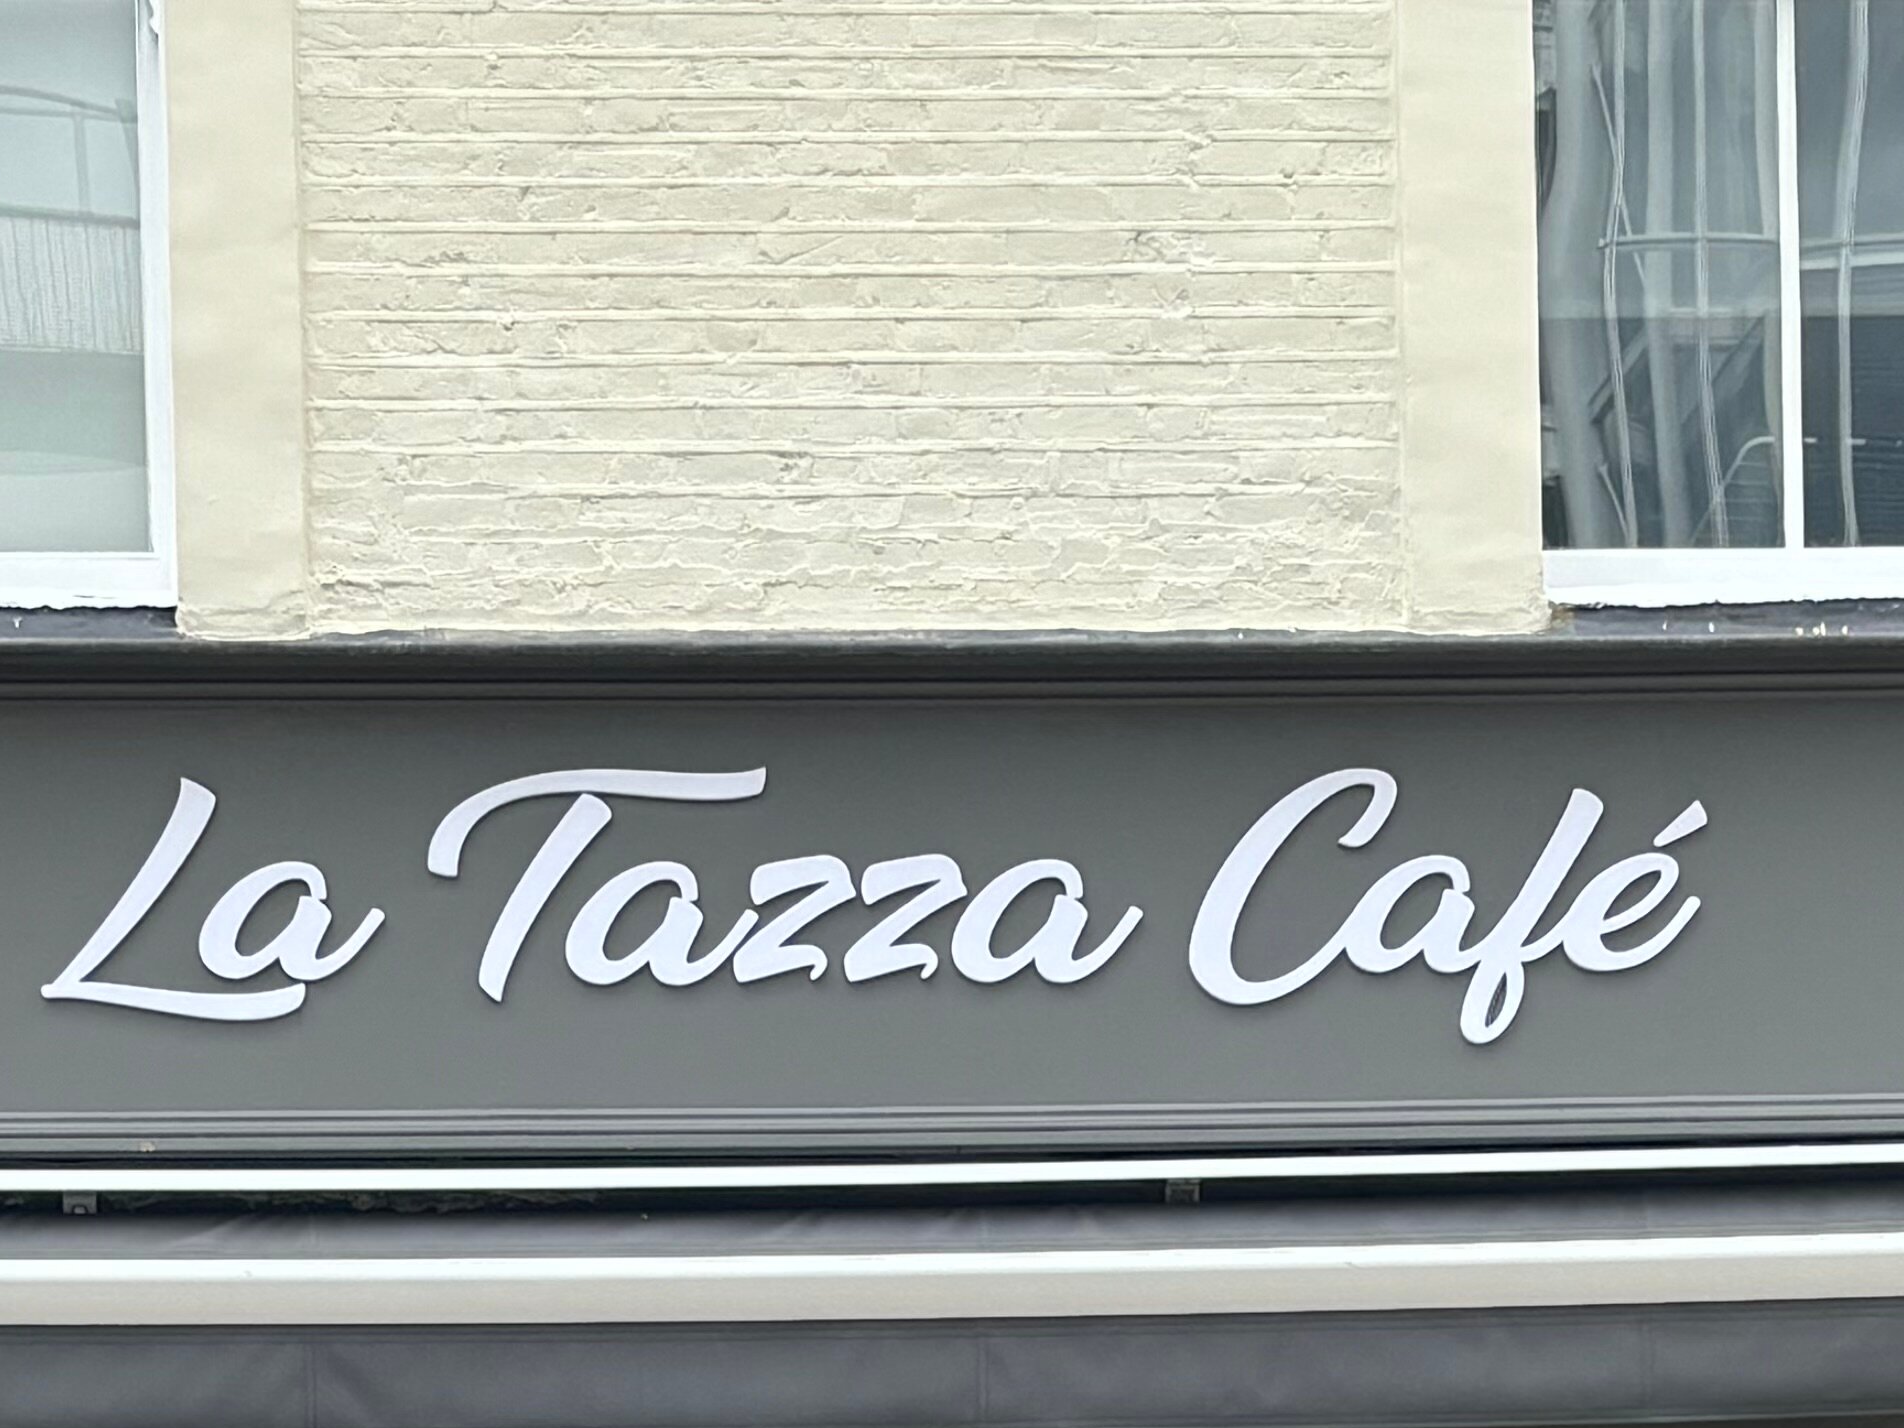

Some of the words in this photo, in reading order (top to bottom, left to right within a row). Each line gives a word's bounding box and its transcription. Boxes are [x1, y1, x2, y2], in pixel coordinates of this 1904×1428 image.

[38, 774, 386, 1023] La
[425, 763, 1142, 1004] Tazza
[1187, 766, 1709, 1046] Café
